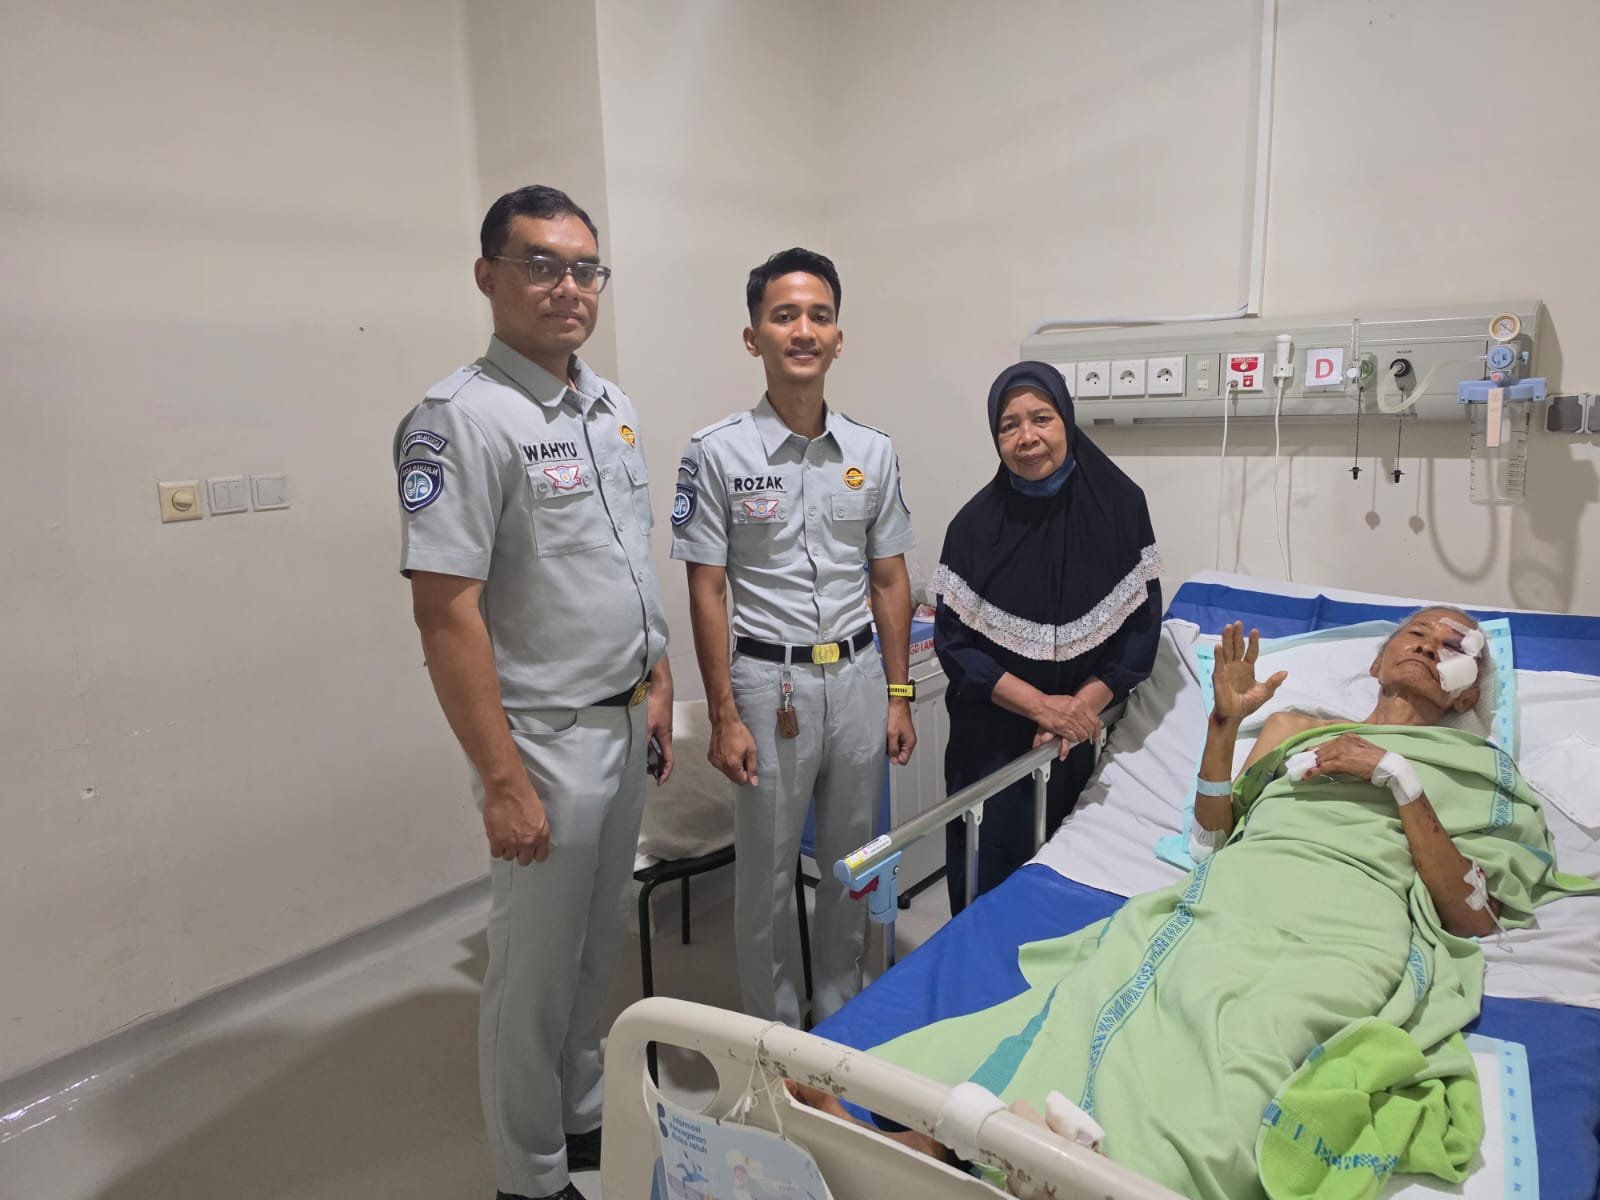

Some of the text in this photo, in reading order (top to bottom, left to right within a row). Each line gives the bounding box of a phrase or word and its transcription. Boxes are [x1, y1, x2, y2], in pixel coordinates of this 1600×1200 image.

[1315, 358, 1334, 379] D
[523, 441, 577, 461] WAHYU
[734, 475, 784, 491] ROZAK
